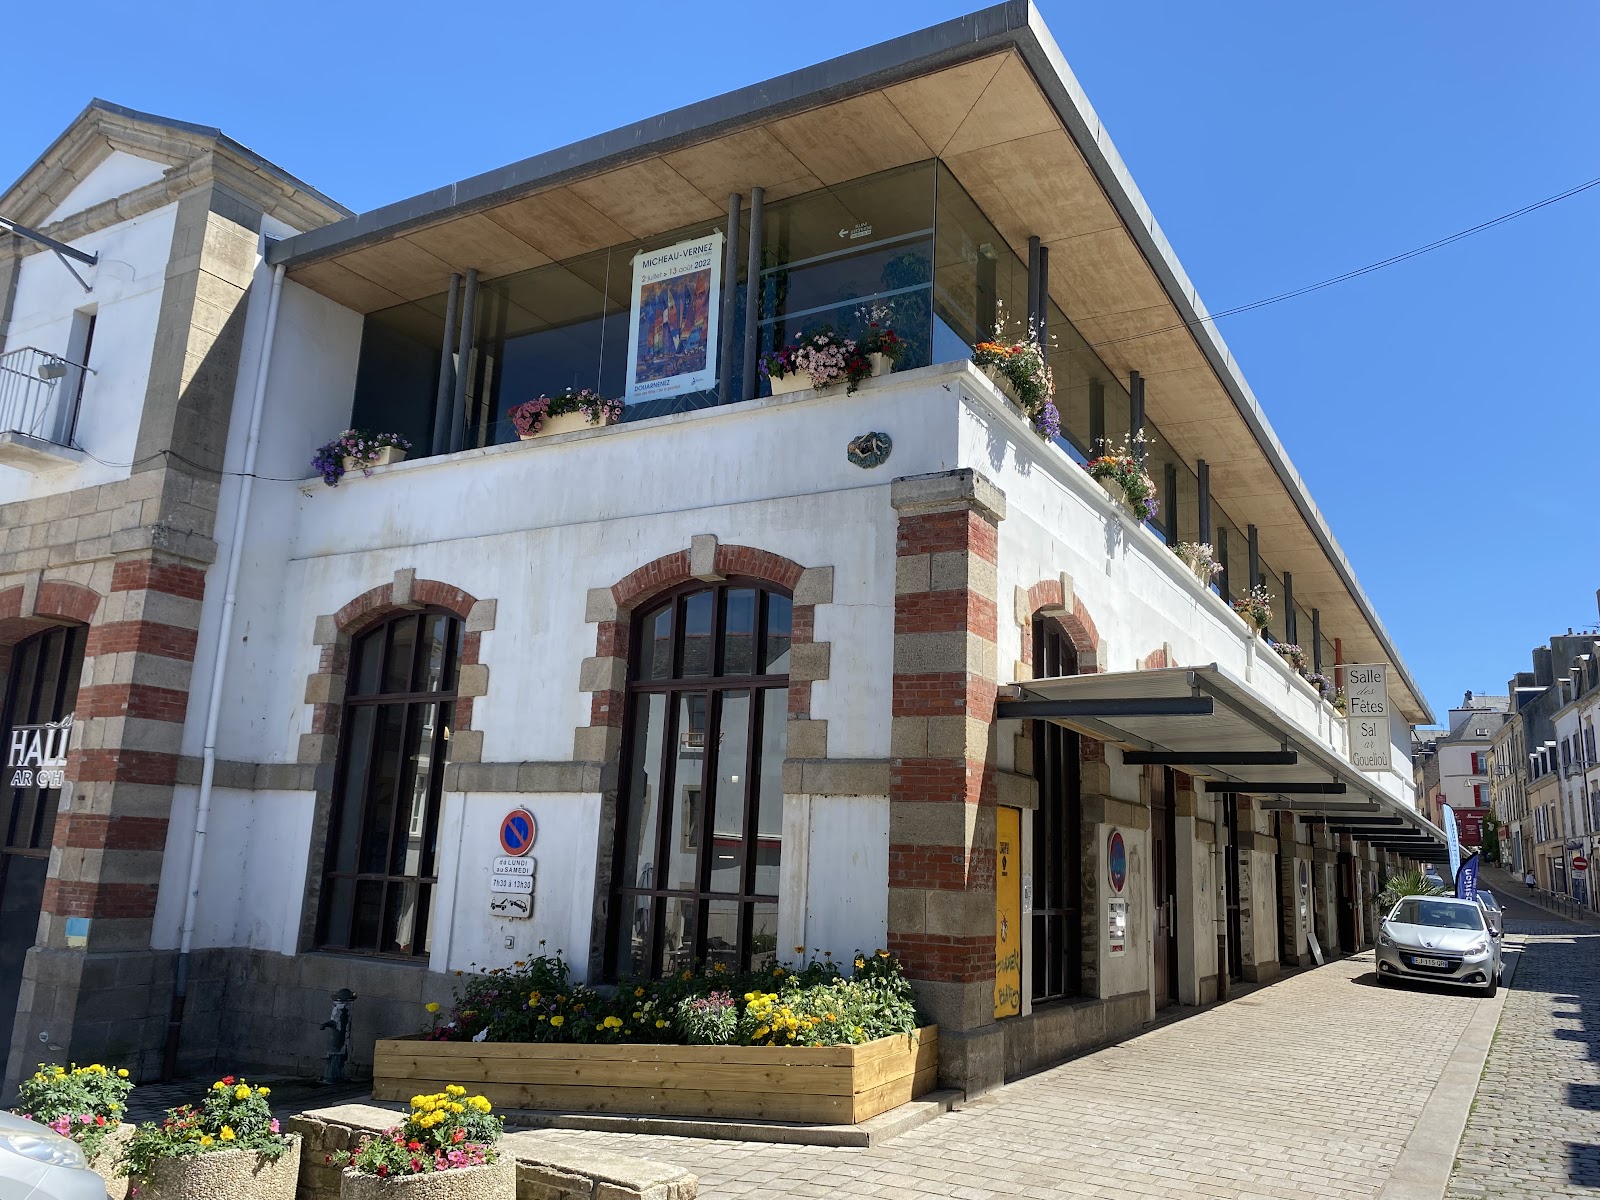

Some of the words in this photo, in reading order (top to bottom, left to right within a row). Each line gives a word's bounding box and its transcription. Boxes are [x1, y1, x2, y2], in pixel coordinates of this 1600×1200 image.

[642, 243, 713, 268] MICHEAU-VERNEZ
[641, 275, 646, 283] 2
[647, 272, 662, 283] juillet
[669, 267, 677, 275] 13
[678, 264, 693, 273] août
[694, 258, 711, 269] 2022
[1350, 669, 1381, 684] Salle
[1356, 686, 1376, 696] des
[1351, 697, 1384, 713] Fêtes
[1361, 722, 1377, 737] Sal
[1364, 740, 1375, 749] ar
[1352, 752, 1388, 767] Gouelioù
[10, 769, 33, 787] AR
[493, 879, 507, 887] 7h30
[513, 880, 531, 889] 13h30
